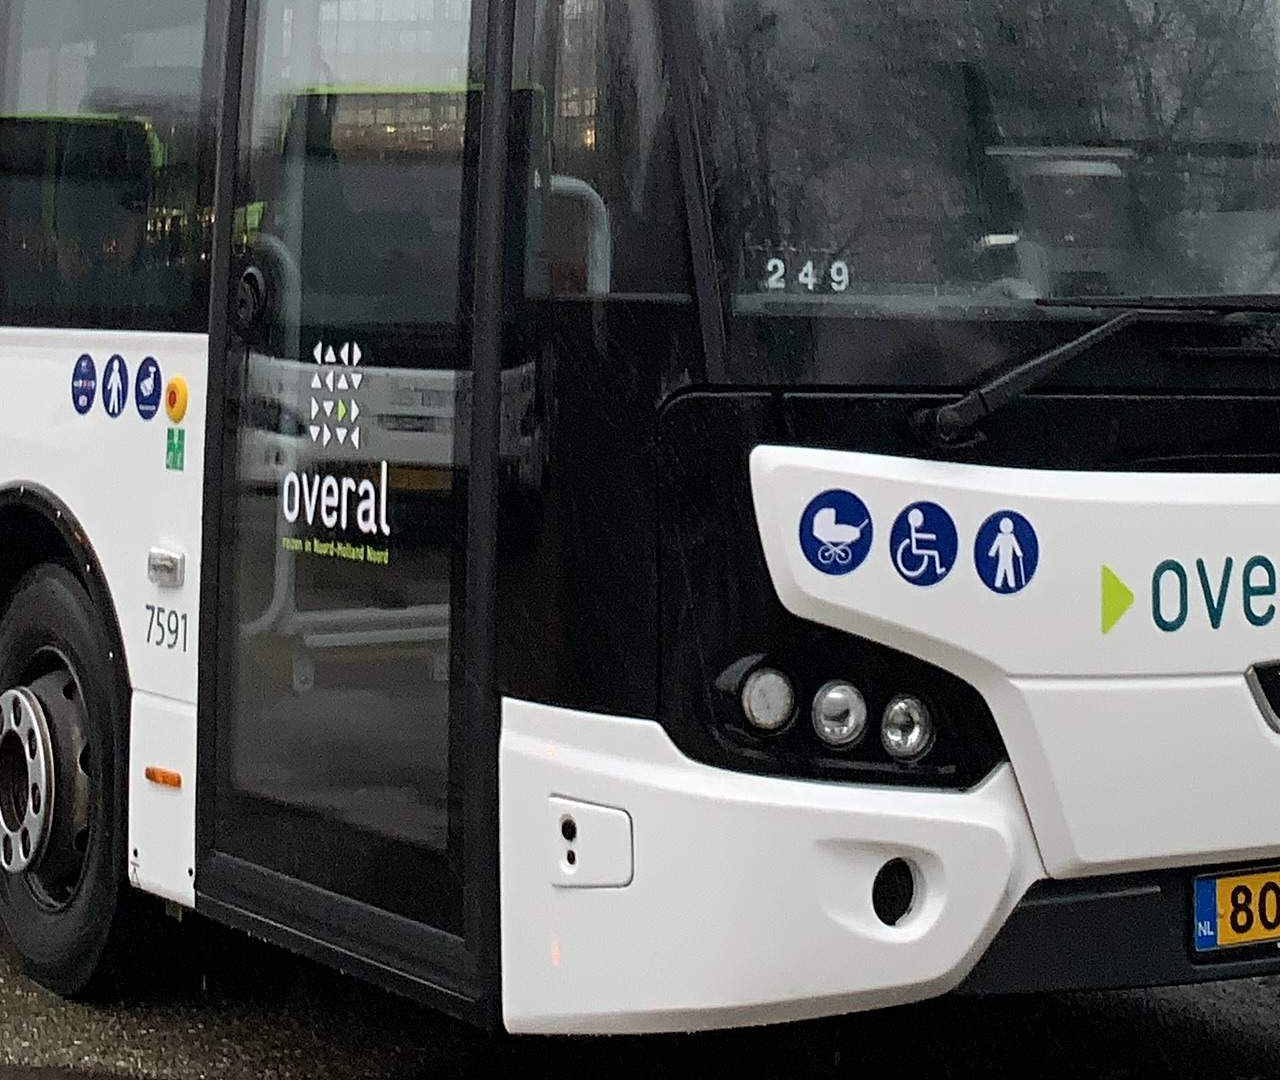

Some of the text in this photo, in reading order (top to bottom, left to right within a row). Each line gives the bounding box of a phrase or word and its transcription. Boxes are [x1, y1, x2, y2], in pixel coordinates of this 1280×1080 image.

[283, 460, 390, 536] overal
[145, 603, 188, 652] 7591
[1198, 921, 1214, 937] NL
